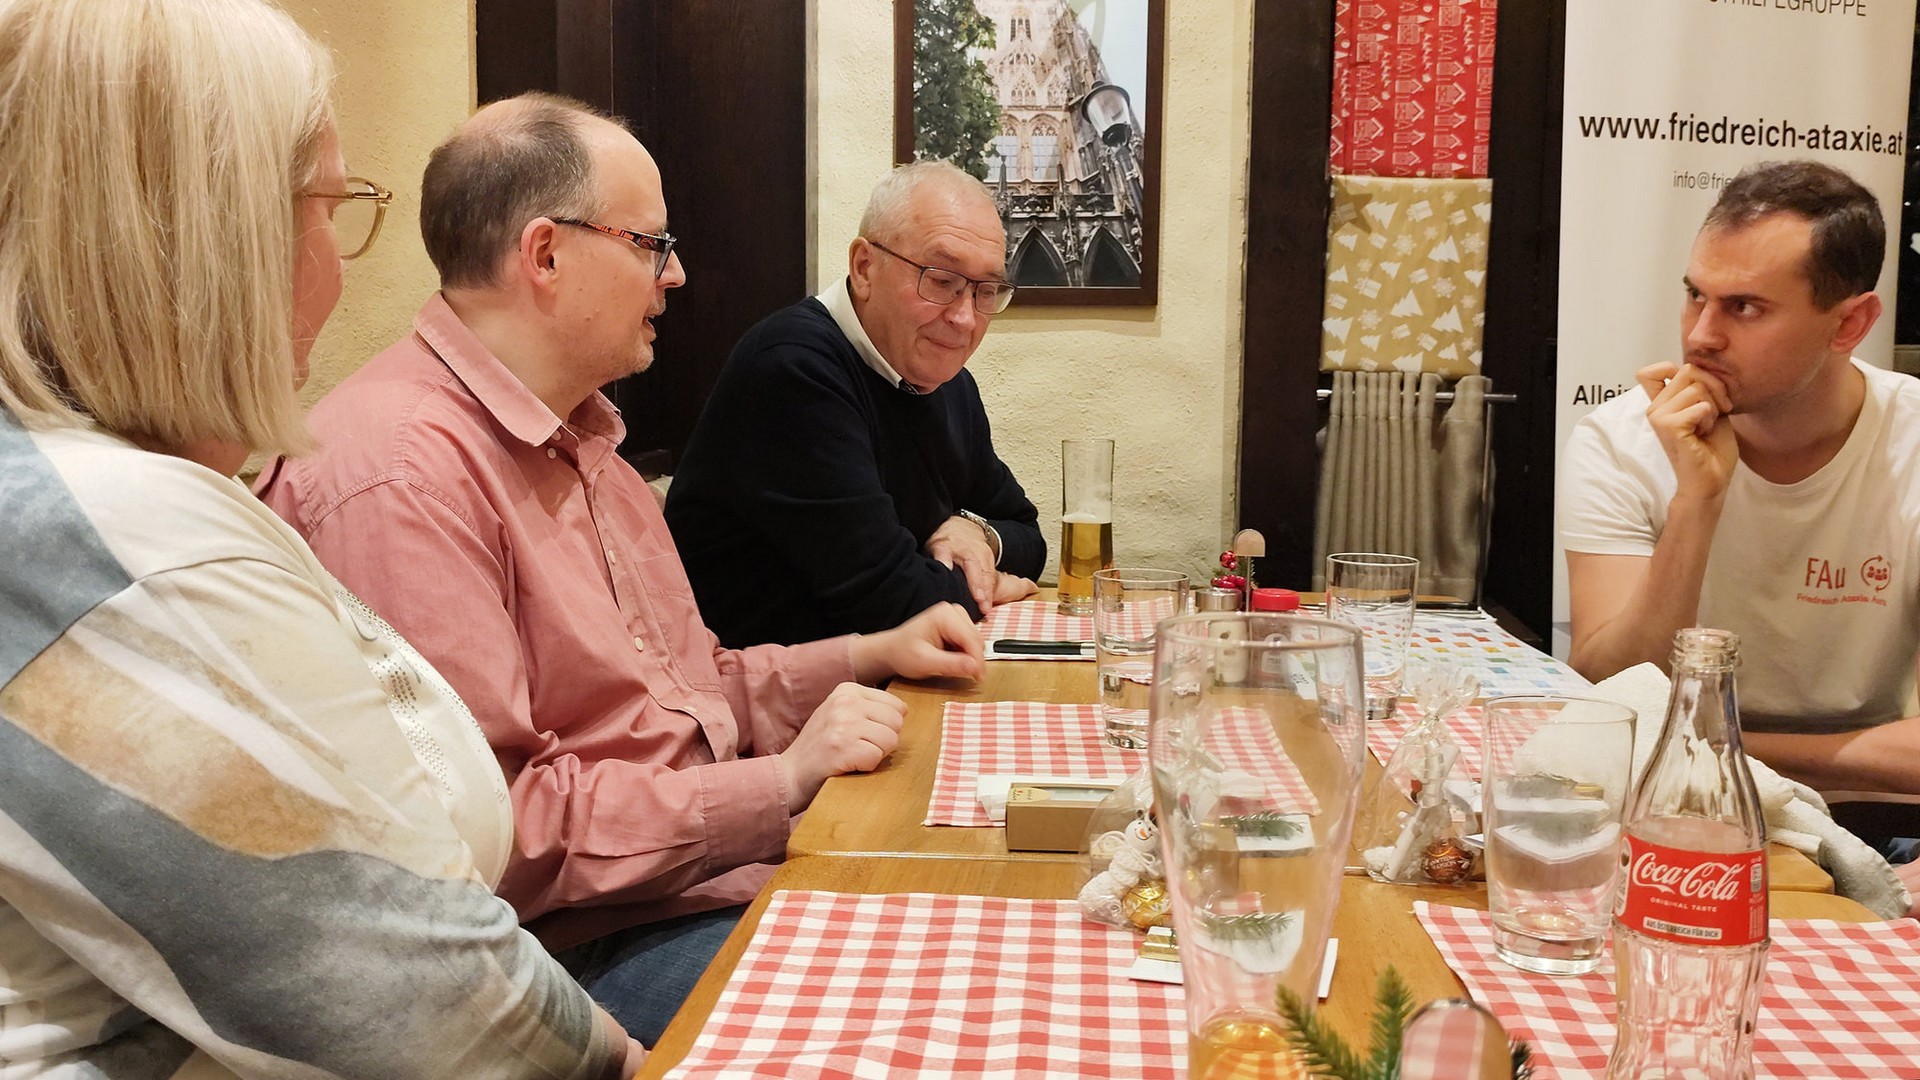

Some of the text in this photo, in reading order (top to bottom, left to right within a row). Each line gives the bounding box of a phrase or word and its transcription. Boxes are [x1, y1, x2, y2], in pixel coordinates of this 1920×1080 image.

[1579, 112, 1903, 156] www.friedreich-ataxie.at
[1572, 384, 1632, 405] Allei
[1632, 852, 1746, 901] Coca-Cola
[1650, 896, 1718, 913] ORIGINAL TASTE
[1646, 919, 1719, 938] AUS ÖSTERREICH FÜR DICH
